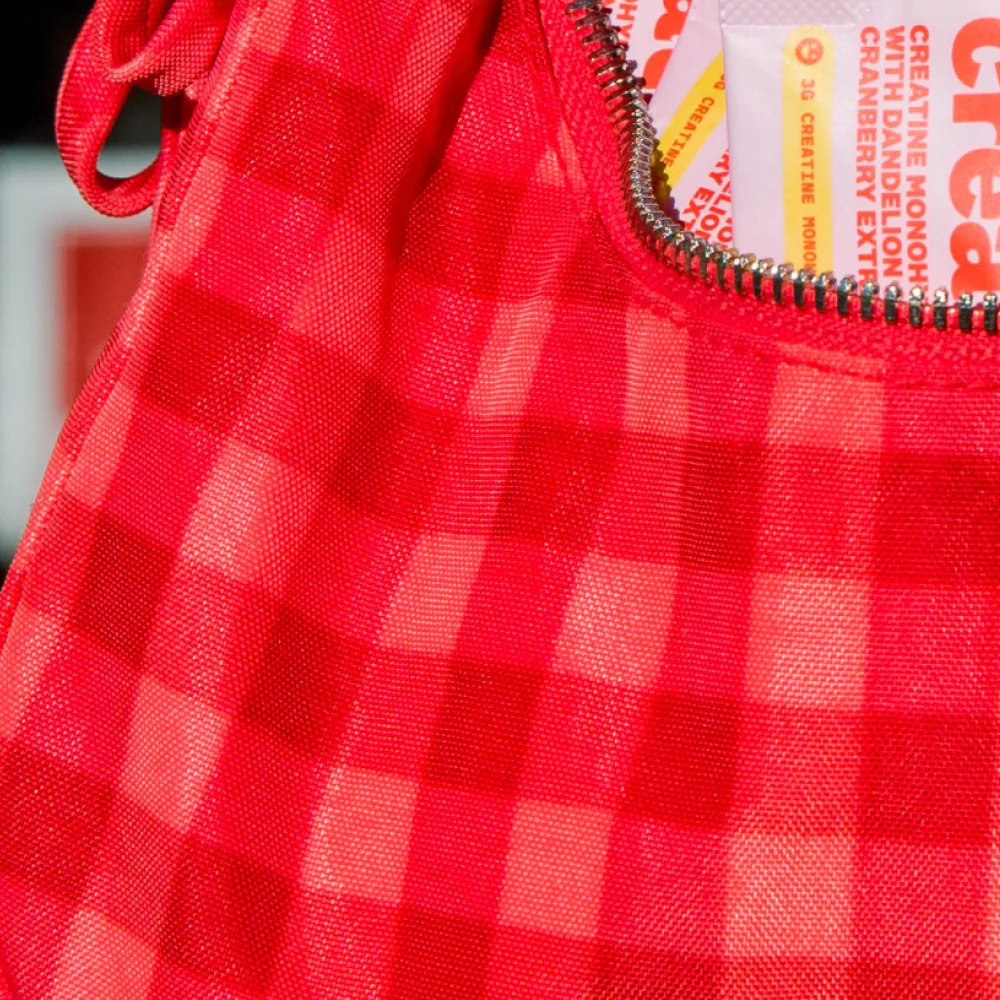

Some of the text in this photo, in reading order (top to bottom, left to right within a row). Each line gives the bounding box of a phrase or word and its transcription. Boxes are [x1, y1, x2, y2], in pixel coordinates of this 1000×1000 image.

[662, 97, 715, 167] CREATINE
[800, 79, 815, 101] 3G
[856, 26, 880, 202] CRANBERRY
[907, 25, 930, 166] CREATINE
[800, 112, 815, 204] CREATINE
[880, 25, 905, 277] WITH DANDELION
